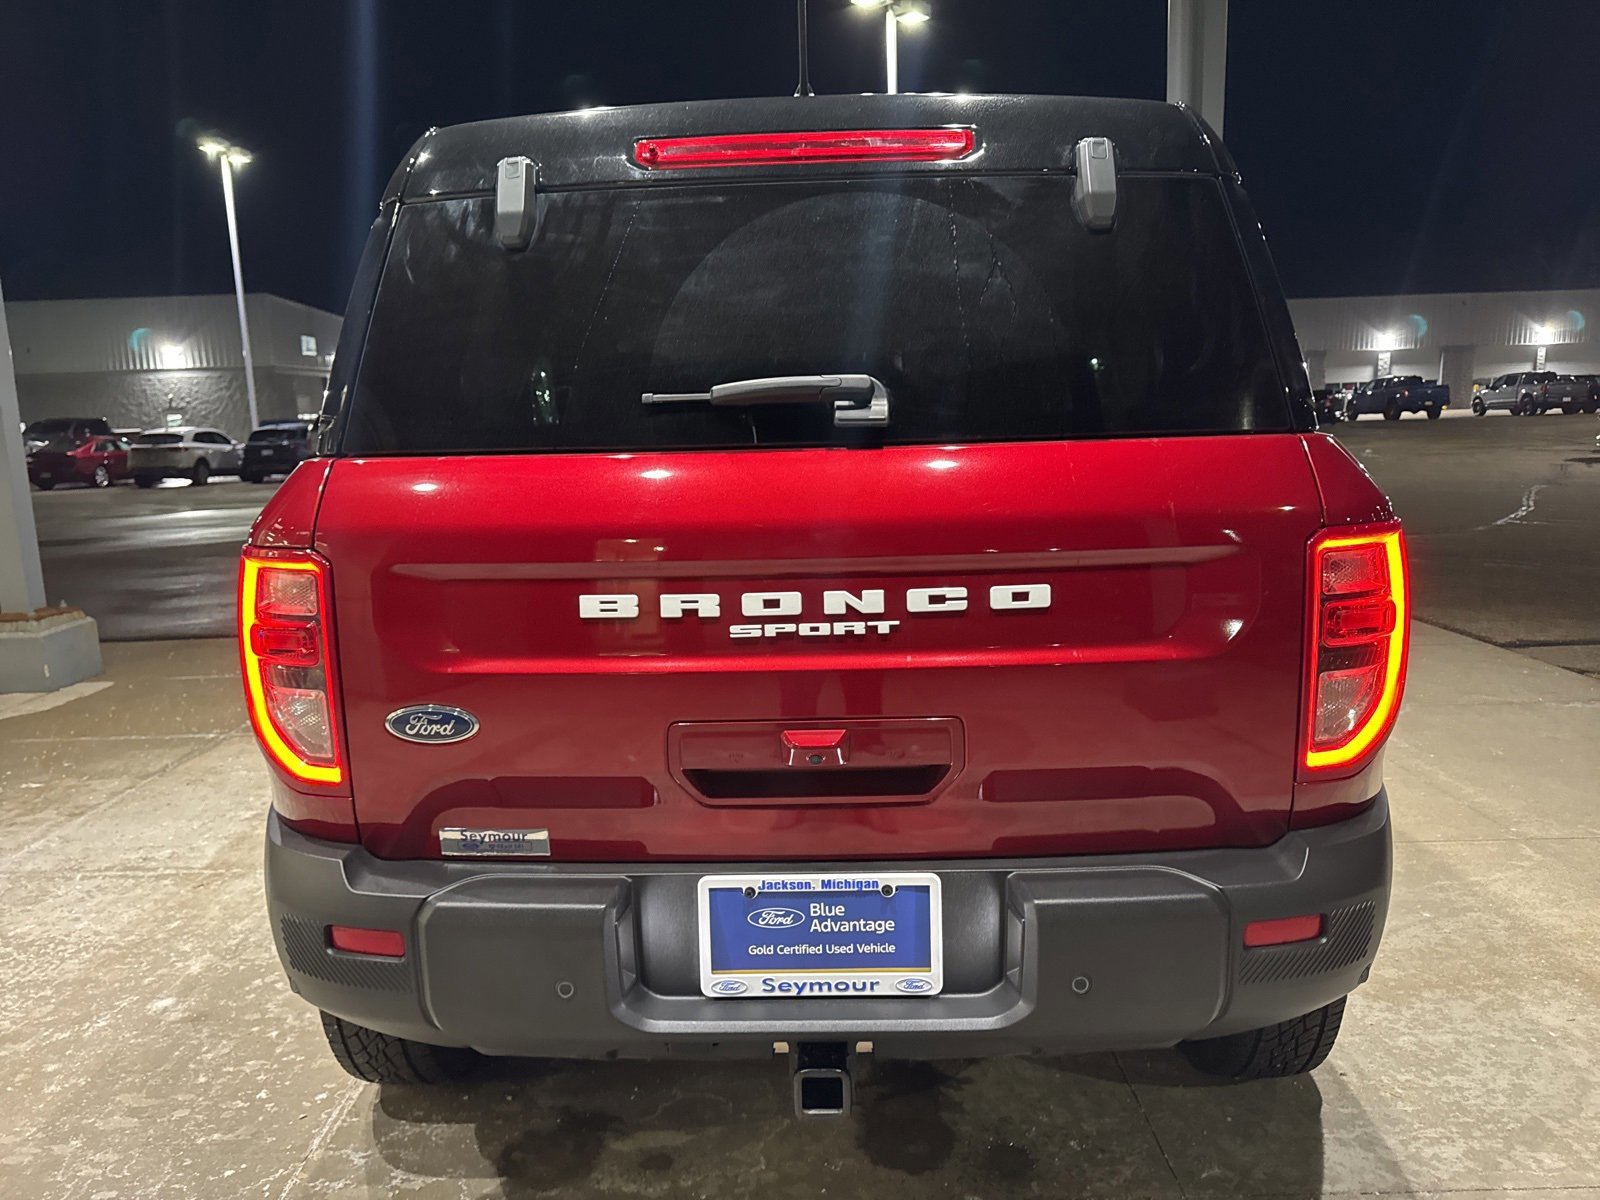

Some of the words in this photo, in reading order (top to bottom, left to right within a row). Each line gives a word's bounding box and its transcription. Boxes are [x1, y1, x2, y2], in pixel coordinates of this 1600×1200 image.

[579, 584, 1051, 618] BRONCO
[729, 620, 900, 638] SPORT
[405, 713, 456, 736] Ford
[460, 830, 528, 844] Seymour
[758, 879, 816, 891] Jackson,
[820, 878, 879, 893] Michigan
[810, 902, 845, 917] Blue
[758, 910, 795, 926] Ford
[810, 918, 896, 934] Advantage
[748, 945, 775, 955] Gold
[777, 944, 823, 955] Certified
[826, 943, 854, 954] Used
[857, 943, 896, 954] Vehicle
[718, 981, 741, 993] Ford
[761, 977, 880, 996] Seymour
[902, 979, 926, 991] Ford
